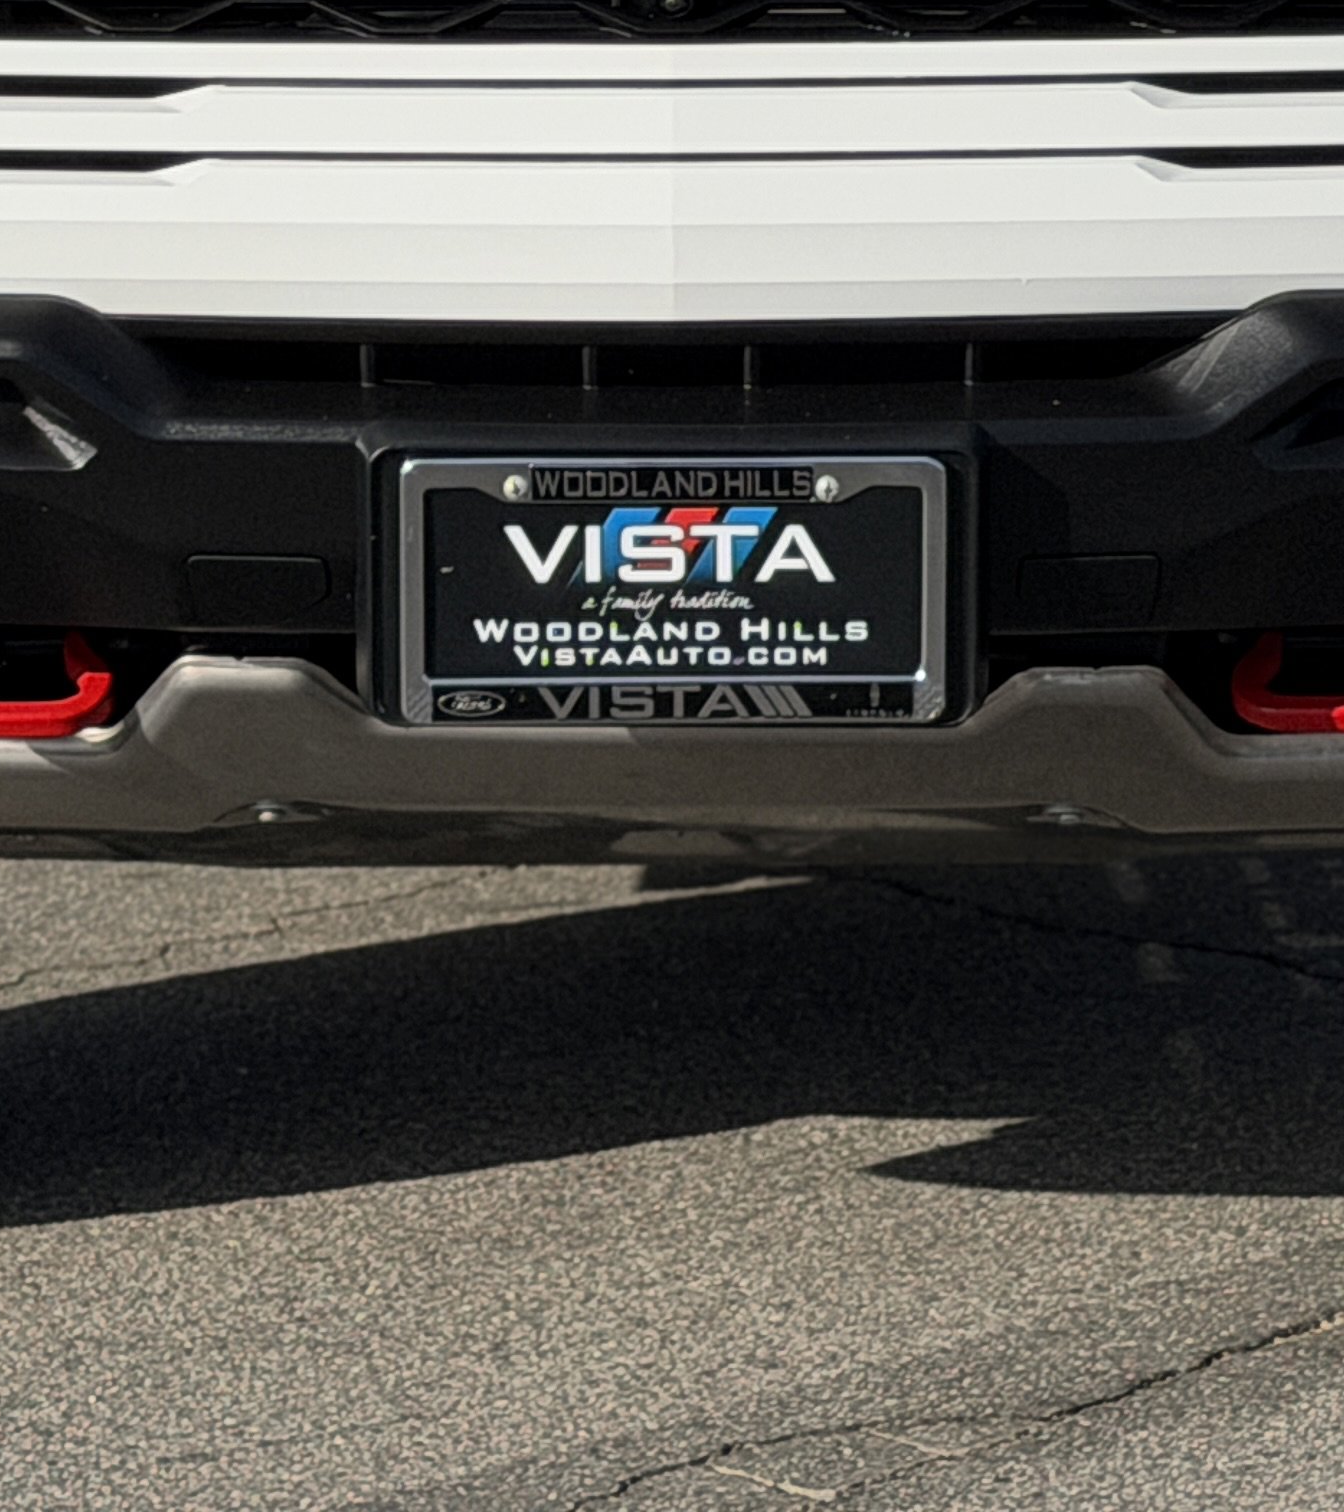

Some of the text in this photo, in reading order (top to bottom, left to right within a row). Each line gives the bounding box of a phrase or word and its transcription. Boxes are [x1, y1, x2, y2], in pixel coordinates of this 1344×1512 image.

[535, 468, 813, 498] WOODLAND HILLS
[504, 523, 836, 584] VISTA
[599, 586, 666, 621] family
[670, 588, 755, 610] tradition
[473, 617, 870, 643] WOODLAND HILLS
[537, 684, 746, 719] VISTA
